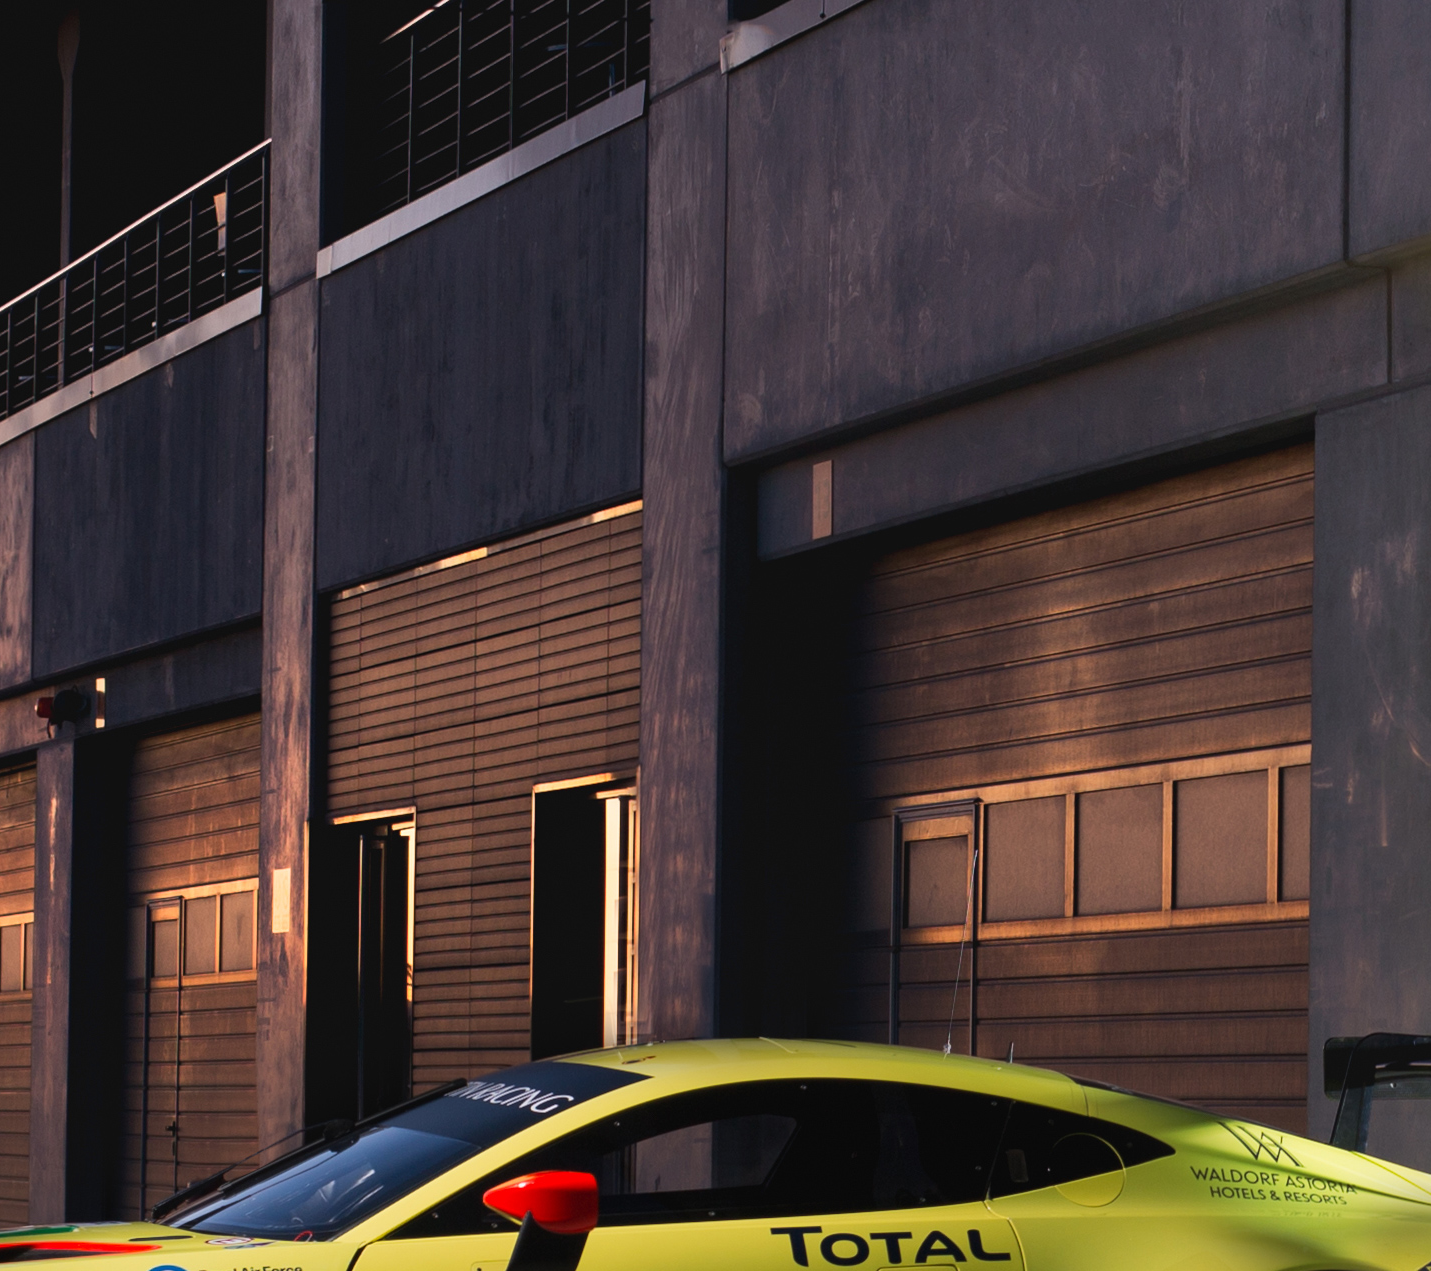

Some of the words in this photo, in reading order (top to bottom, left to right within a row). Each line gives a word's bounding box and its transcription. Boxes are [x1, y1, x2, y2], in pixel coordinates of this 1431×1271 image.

[1190, 1166, 1280, 1187] WALDORF
[1285, 1175, 1358, 1195] ASTORIA
[1209, 1185, 1267, 1201] HOTELS
[1270, 1191, 1282, 1202] &
[1284, 1191, 1348, 1206] RESORTS
[770, 1225, 1012, 1268] TOTAL
